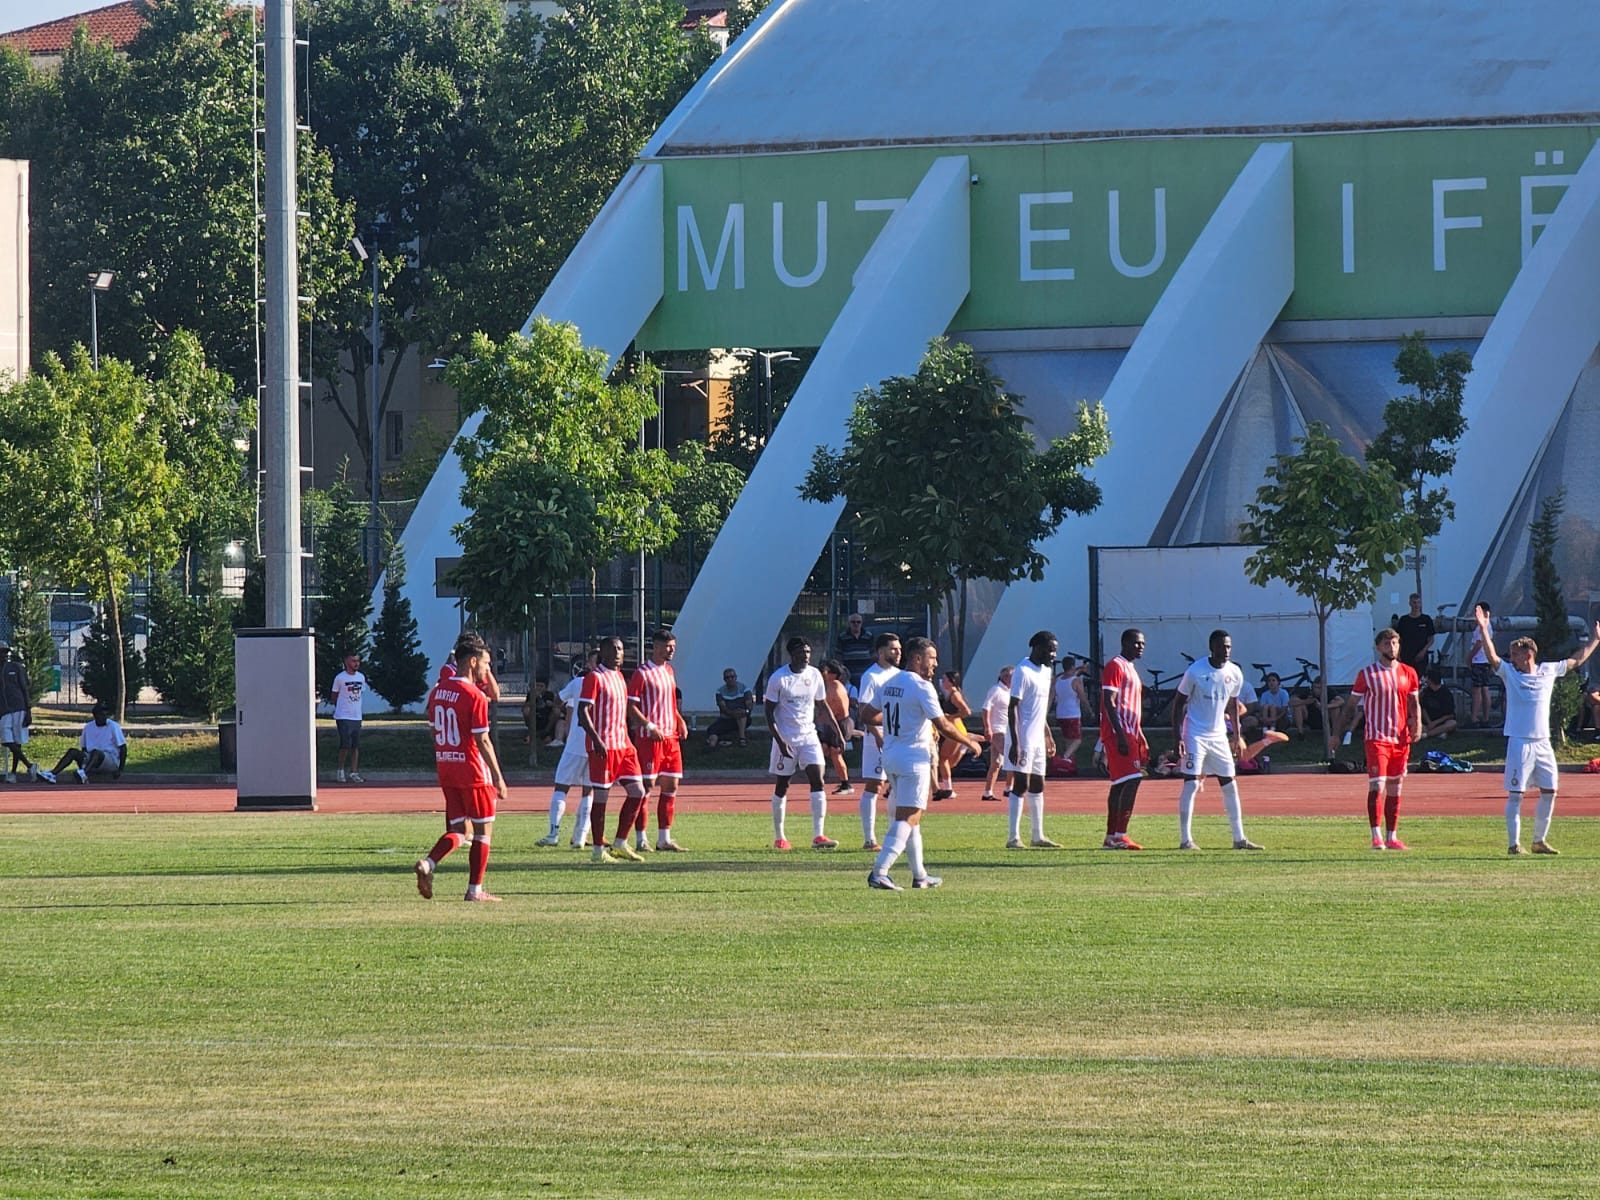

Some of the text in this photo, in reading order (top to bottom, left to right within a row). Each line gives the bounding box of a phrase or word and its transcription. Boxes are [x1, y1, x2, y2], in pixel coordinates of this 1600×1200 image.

[1342, 183, 1355, 274] I
[434, 704, 461, 747] 90
[884, 701, 901, 737] 14
